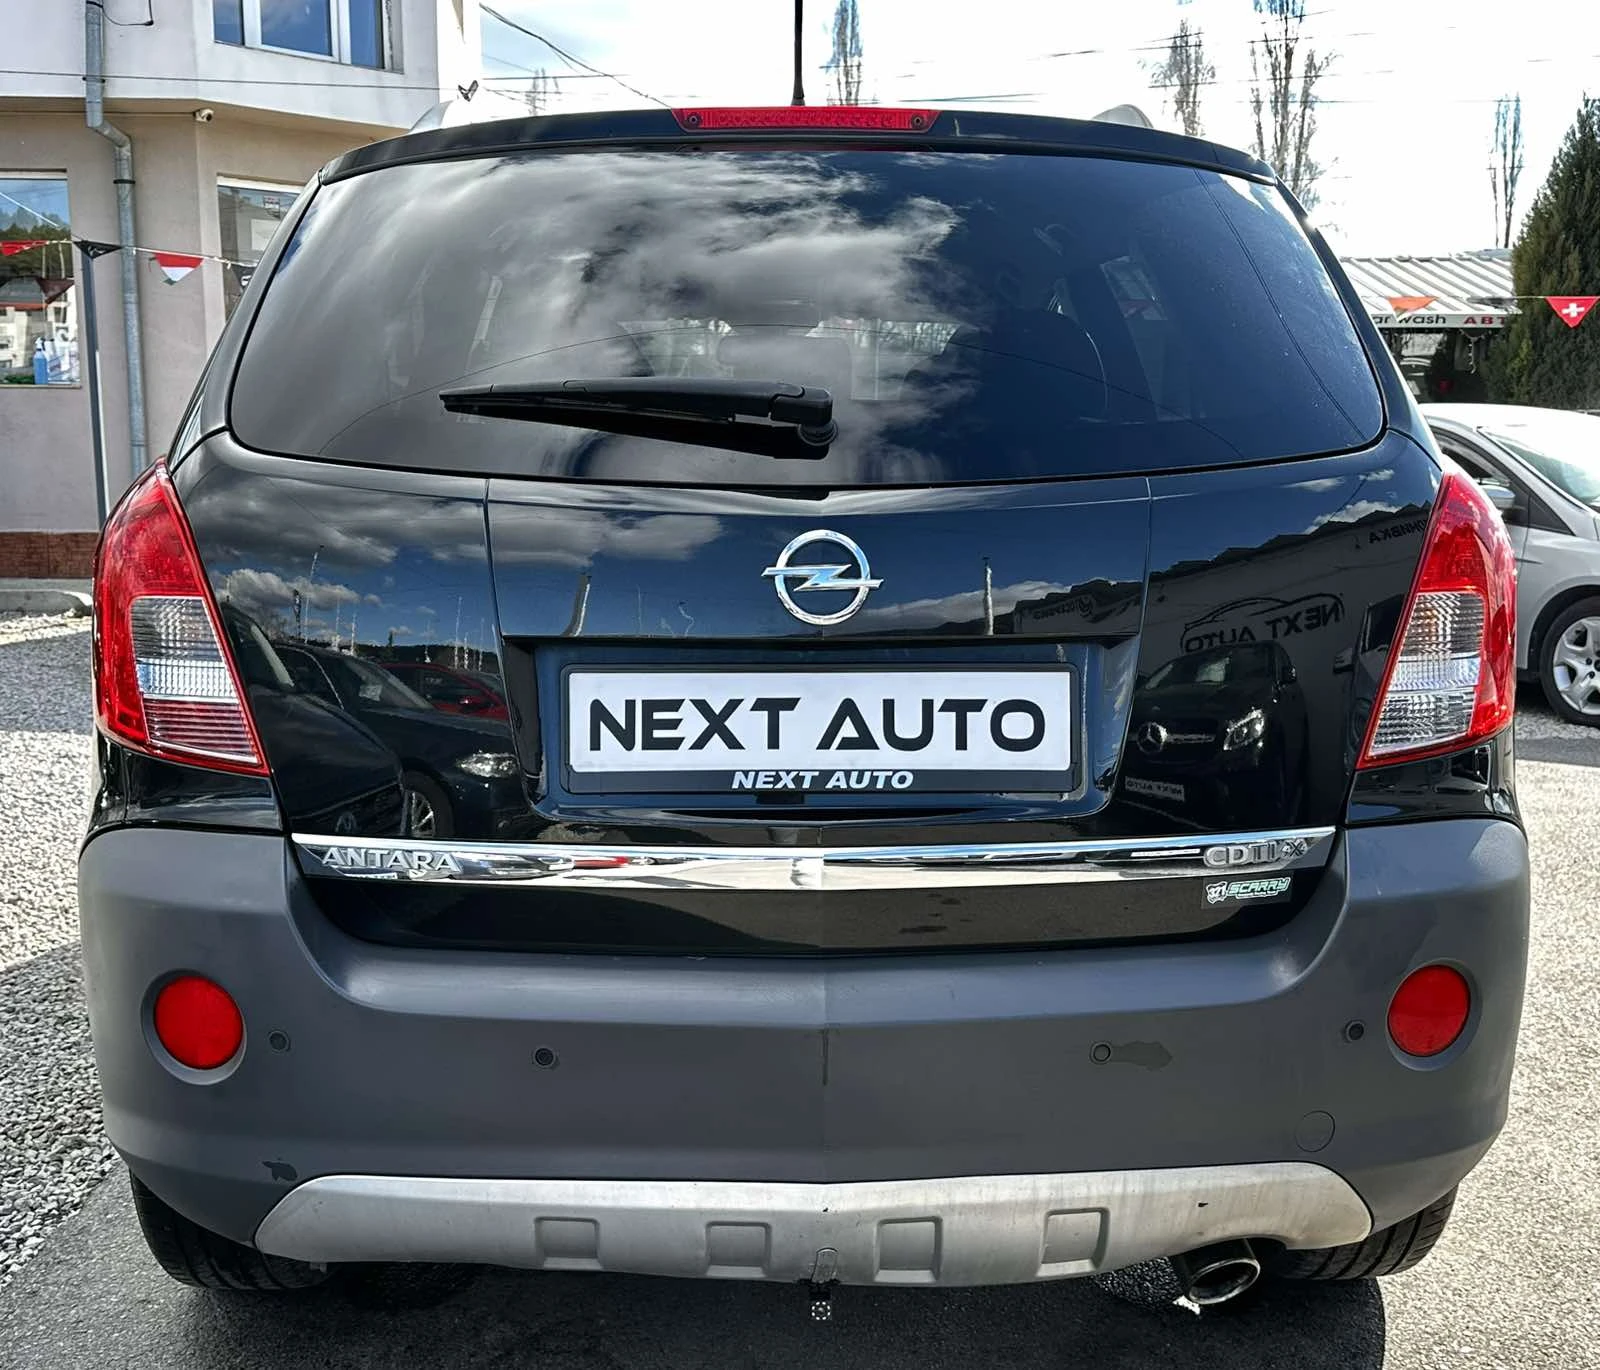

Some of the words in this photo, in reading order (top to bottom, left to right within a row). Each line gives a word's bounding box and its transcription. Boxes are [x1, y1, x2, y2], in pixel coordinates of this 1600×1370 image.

[1373, 316, 1391, 325] ar
[1464, 315, 1506, 325] АВТ
[589, 697, 802, 751] NEXT
[816, 697, 1046, 752] AUTO
[731, 770, 819, 790] NEXT
[825, 770, 914, 790] AUTO
[321, 846, 463, 873] ANTARA
[1205, 841, 1276, 867] CDTI
